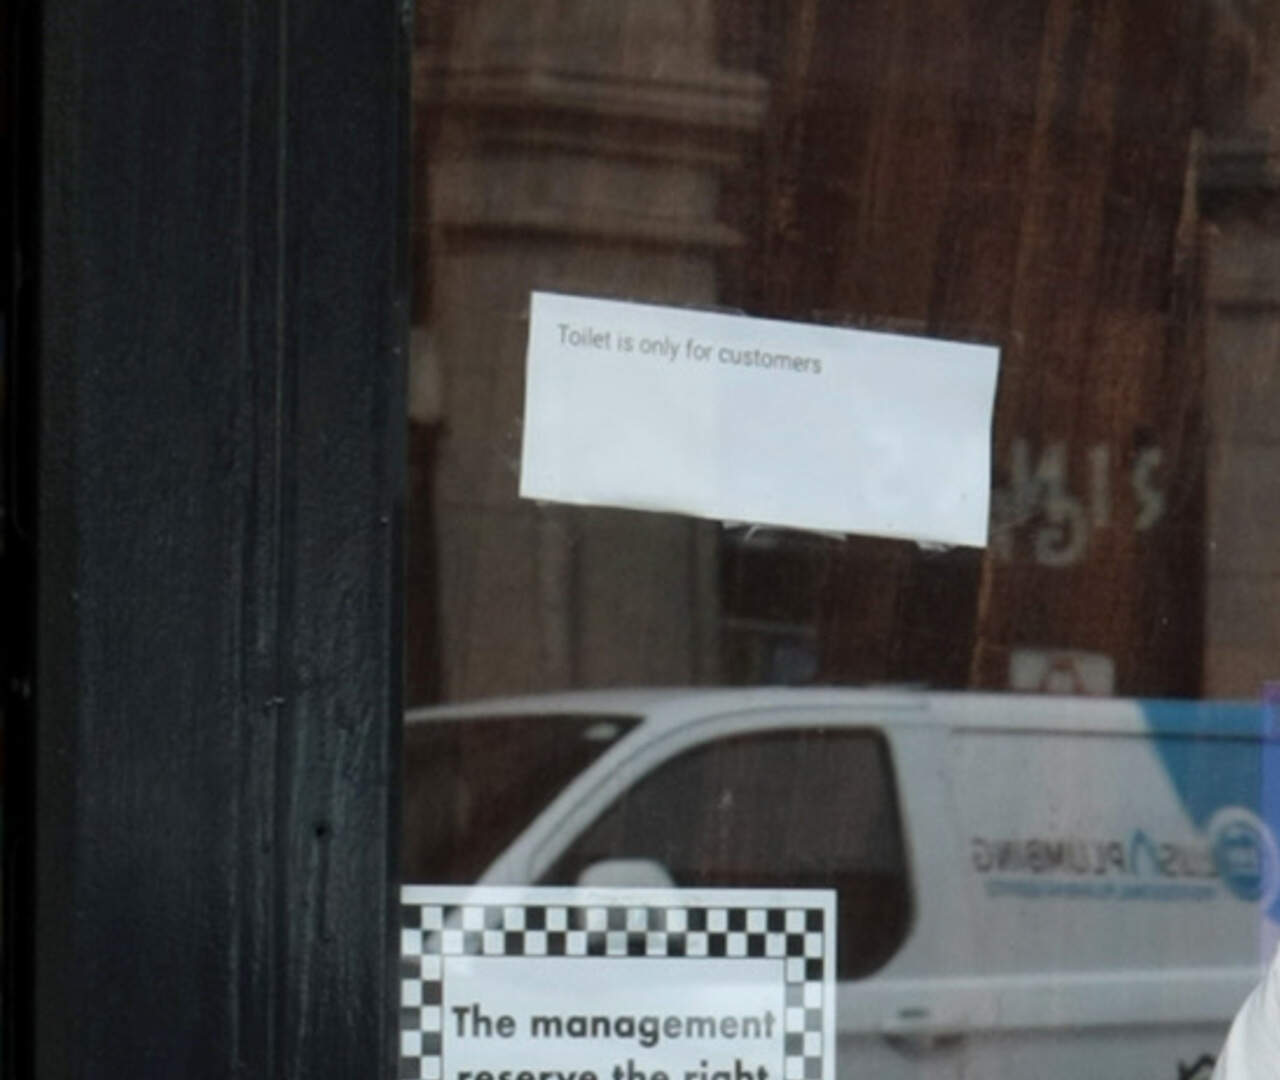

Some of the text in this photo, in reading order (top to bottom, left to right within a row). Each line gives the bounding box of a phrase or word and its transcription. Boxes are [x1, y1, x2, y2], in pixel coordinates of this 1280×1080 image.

[558, 323, 823, 375] Toilet is only for customers
[452, 1004, 776, 1047] The management
